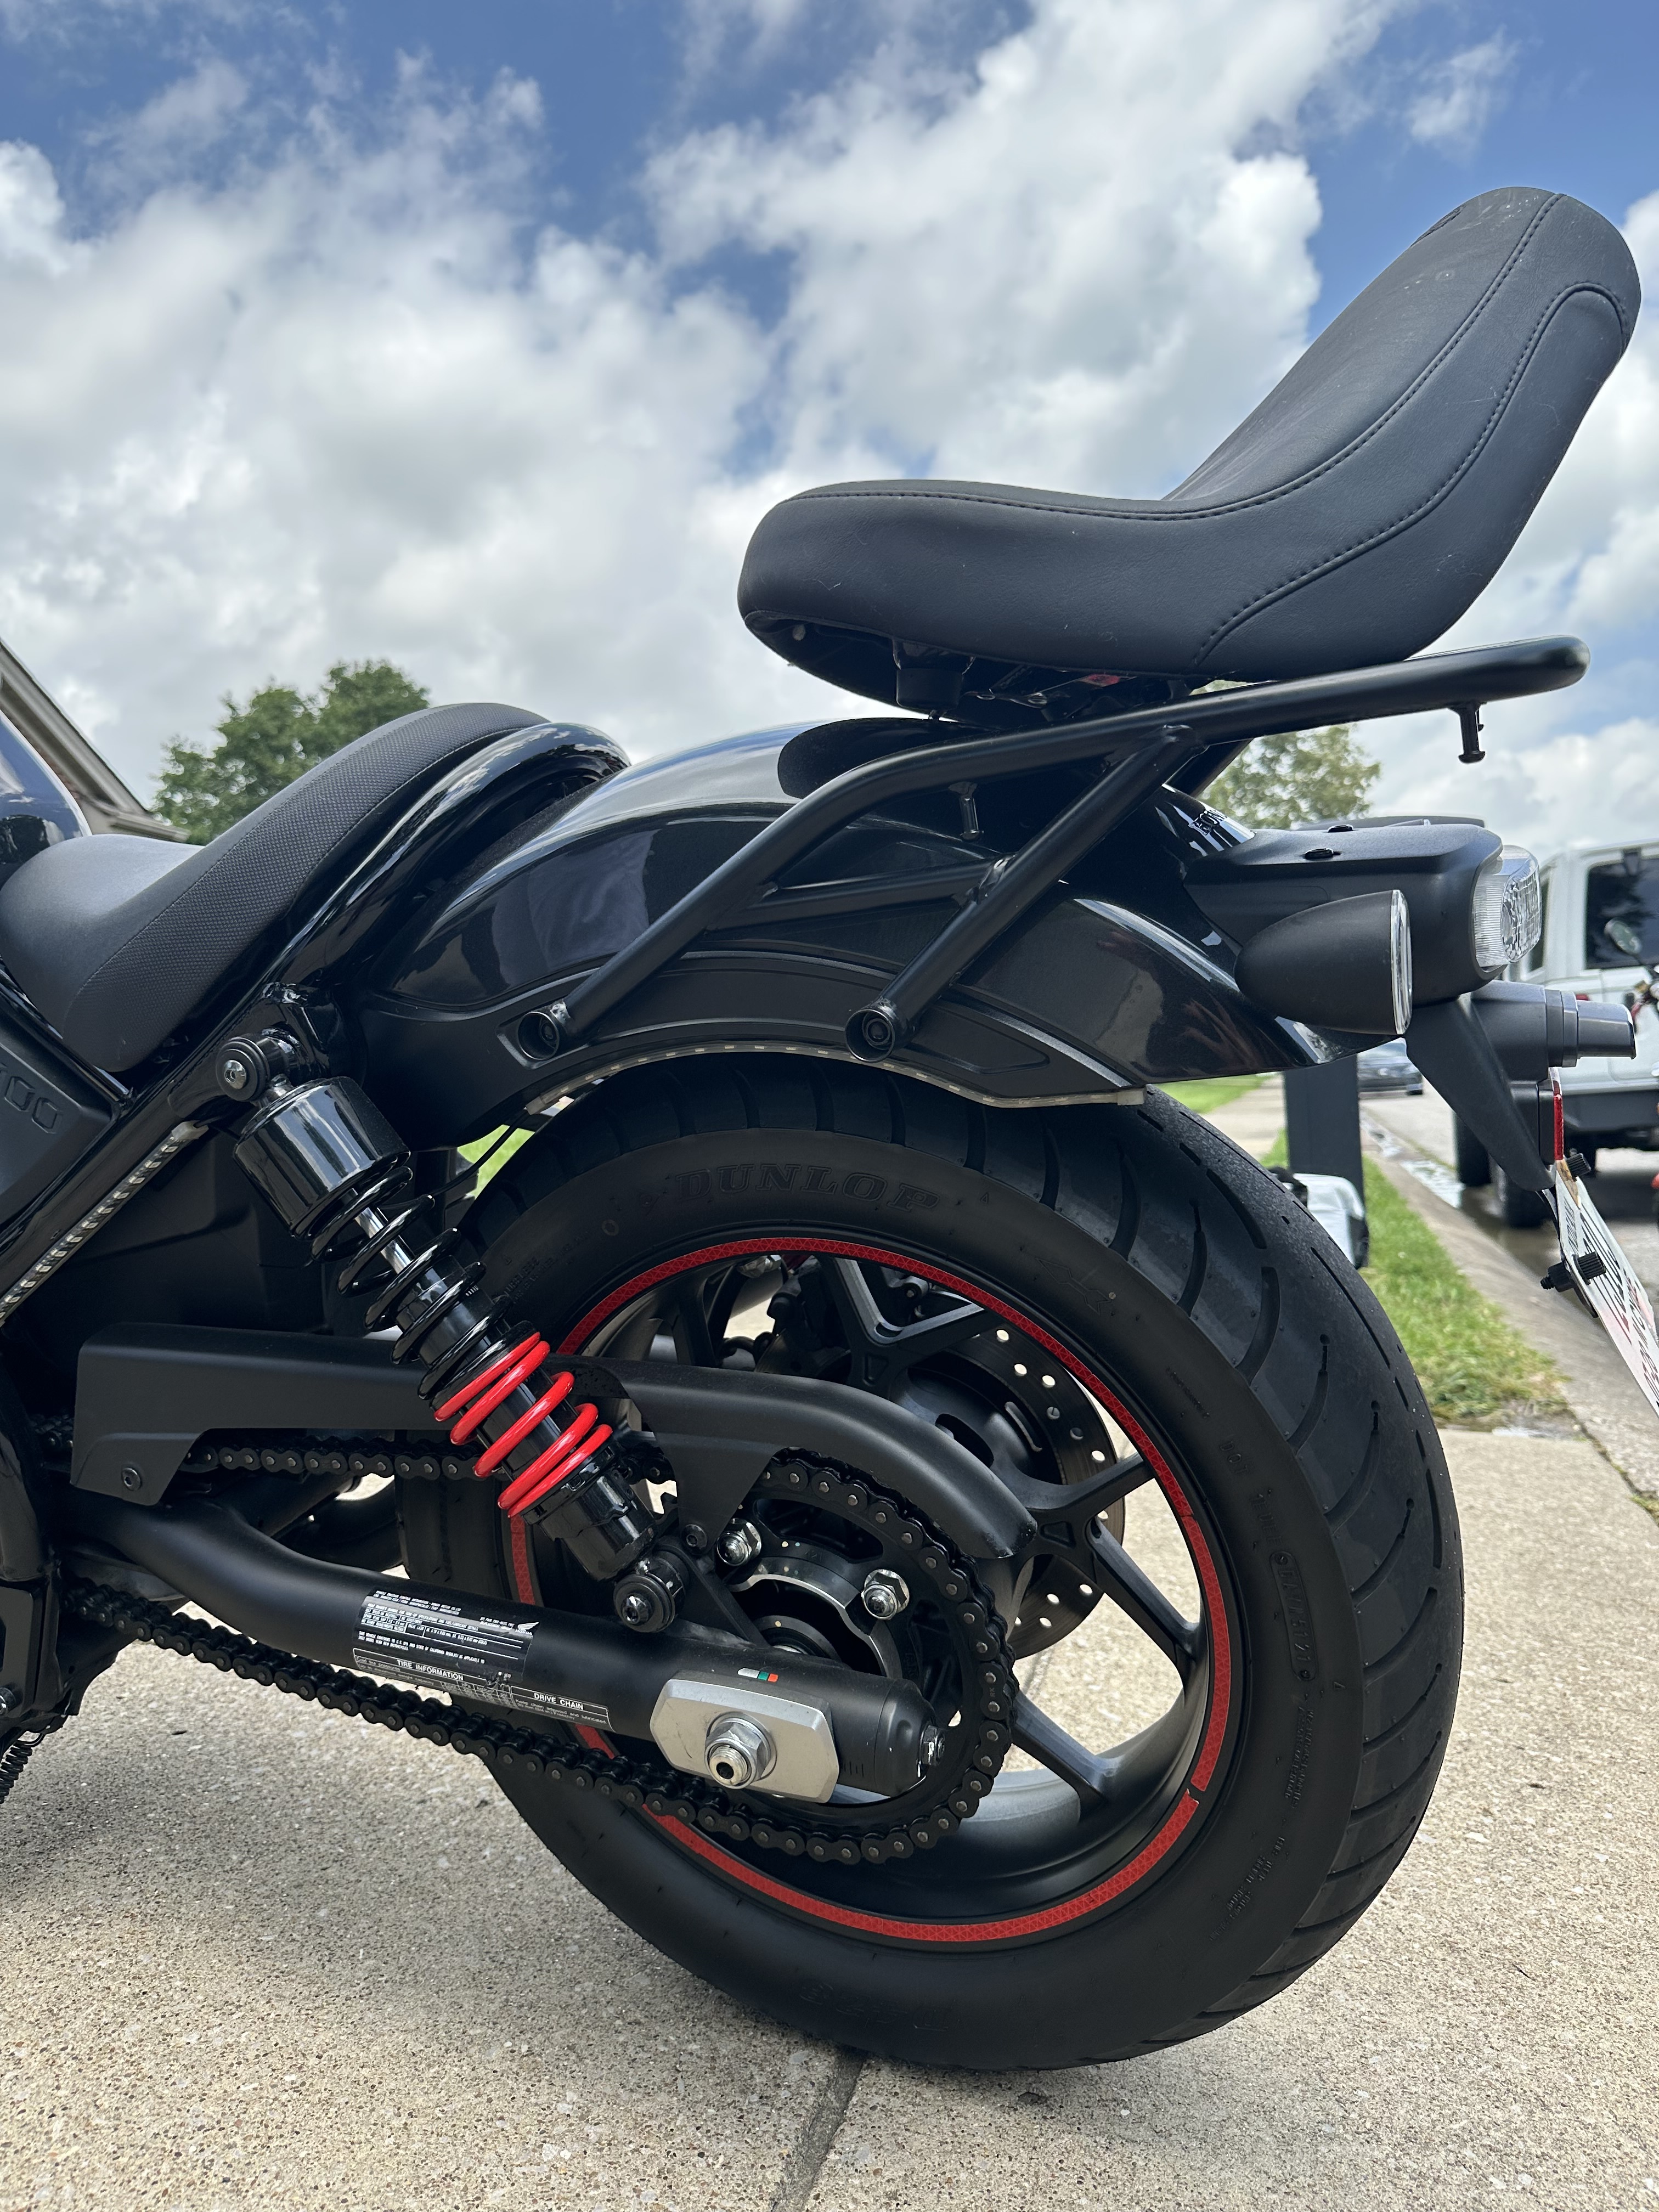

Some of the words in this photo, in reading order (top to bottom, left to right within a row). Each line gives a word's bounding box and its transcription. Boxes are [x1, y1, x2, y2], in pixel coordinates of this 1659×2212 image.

[675, 1164, 940, 1211] DUNLOP
[397, 1660, 413, 1669] TIRE
[415, 1664, 464, 1681] INFORMATION
[534, 1692, 557, 1704] DRIVE
[560, 1699, 584, 1710] CHAIN
